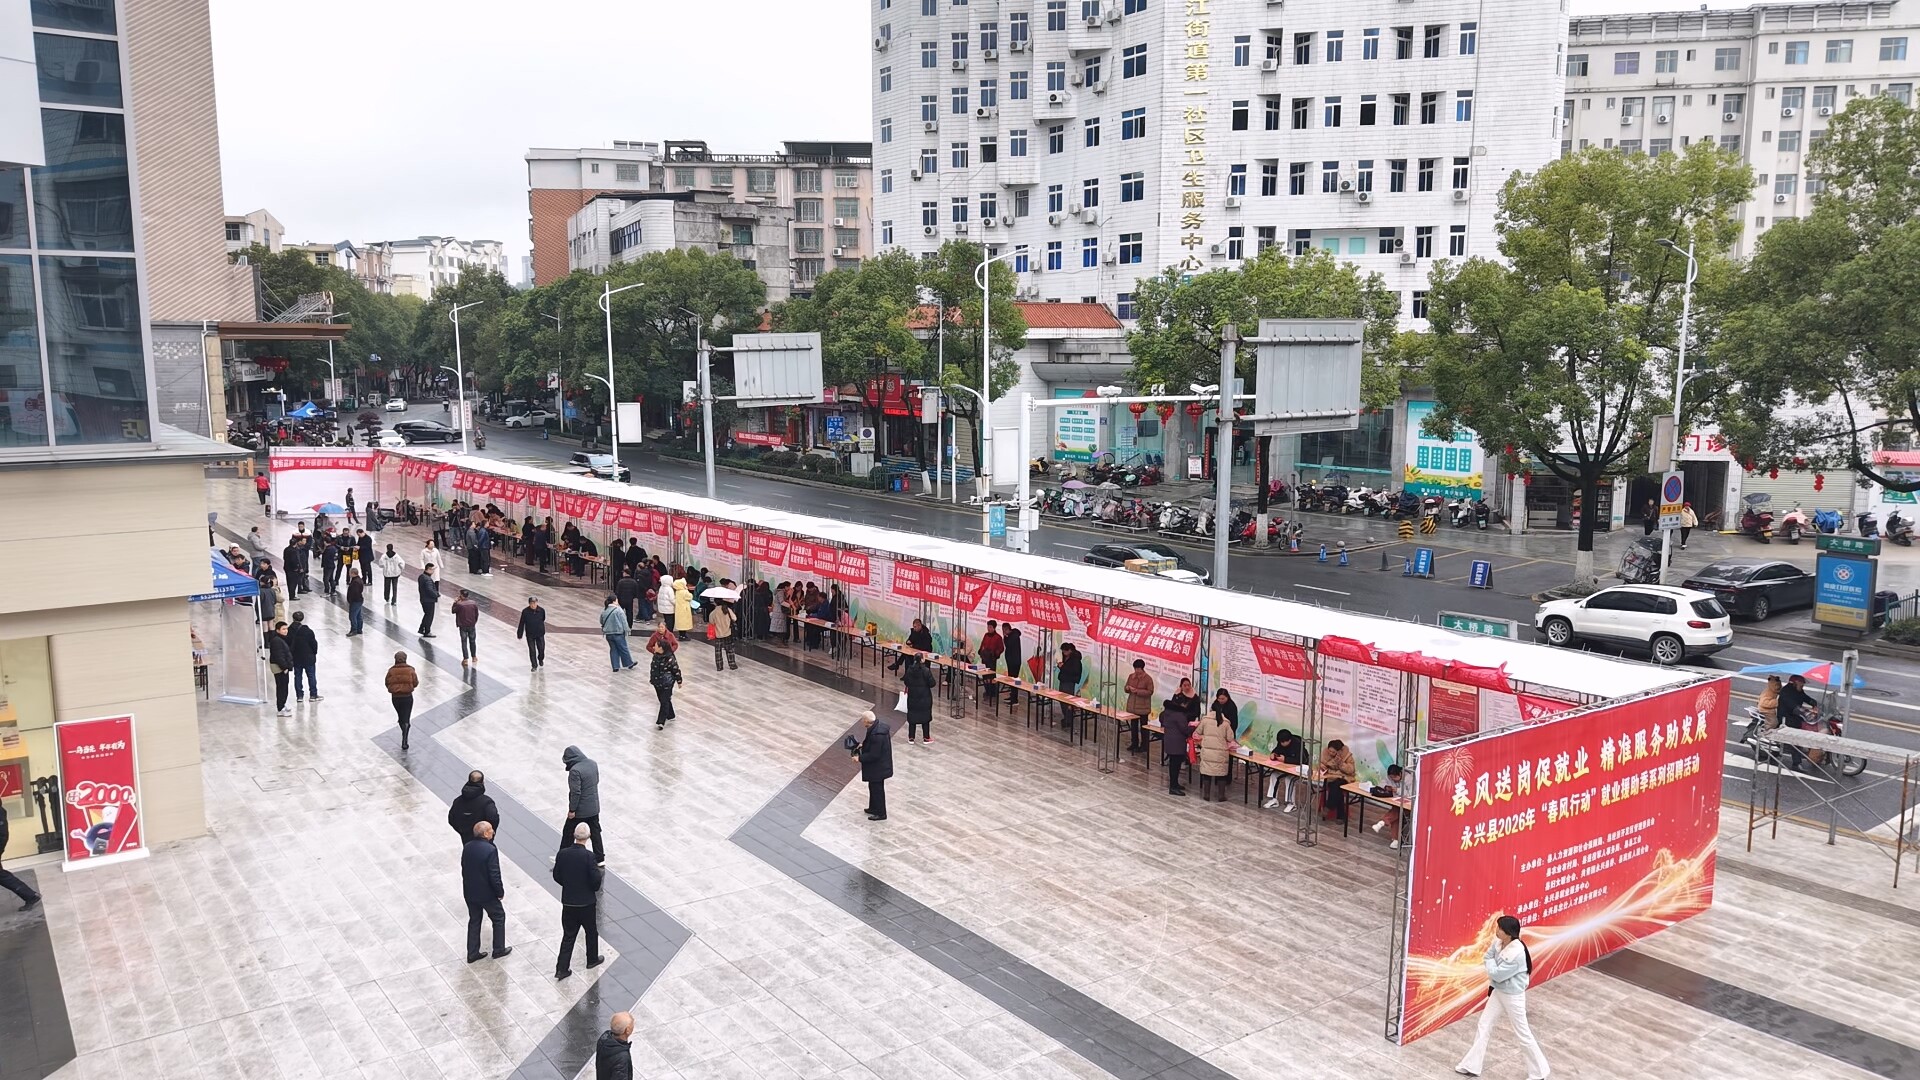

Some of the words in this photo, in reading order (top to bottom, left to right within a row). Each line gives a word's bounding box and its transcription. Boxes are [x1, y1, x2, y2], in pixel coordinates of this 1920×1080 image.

[1829, 538, 1864, 549] 大桥路
[1453, 620, 1494, 634] 大桥路
[1451, 745, 1590, 816] 春风送岗促就业
[1599, 710, 1709, 772] 精准服务助发展
[77, 783, 132, 806] 2000
